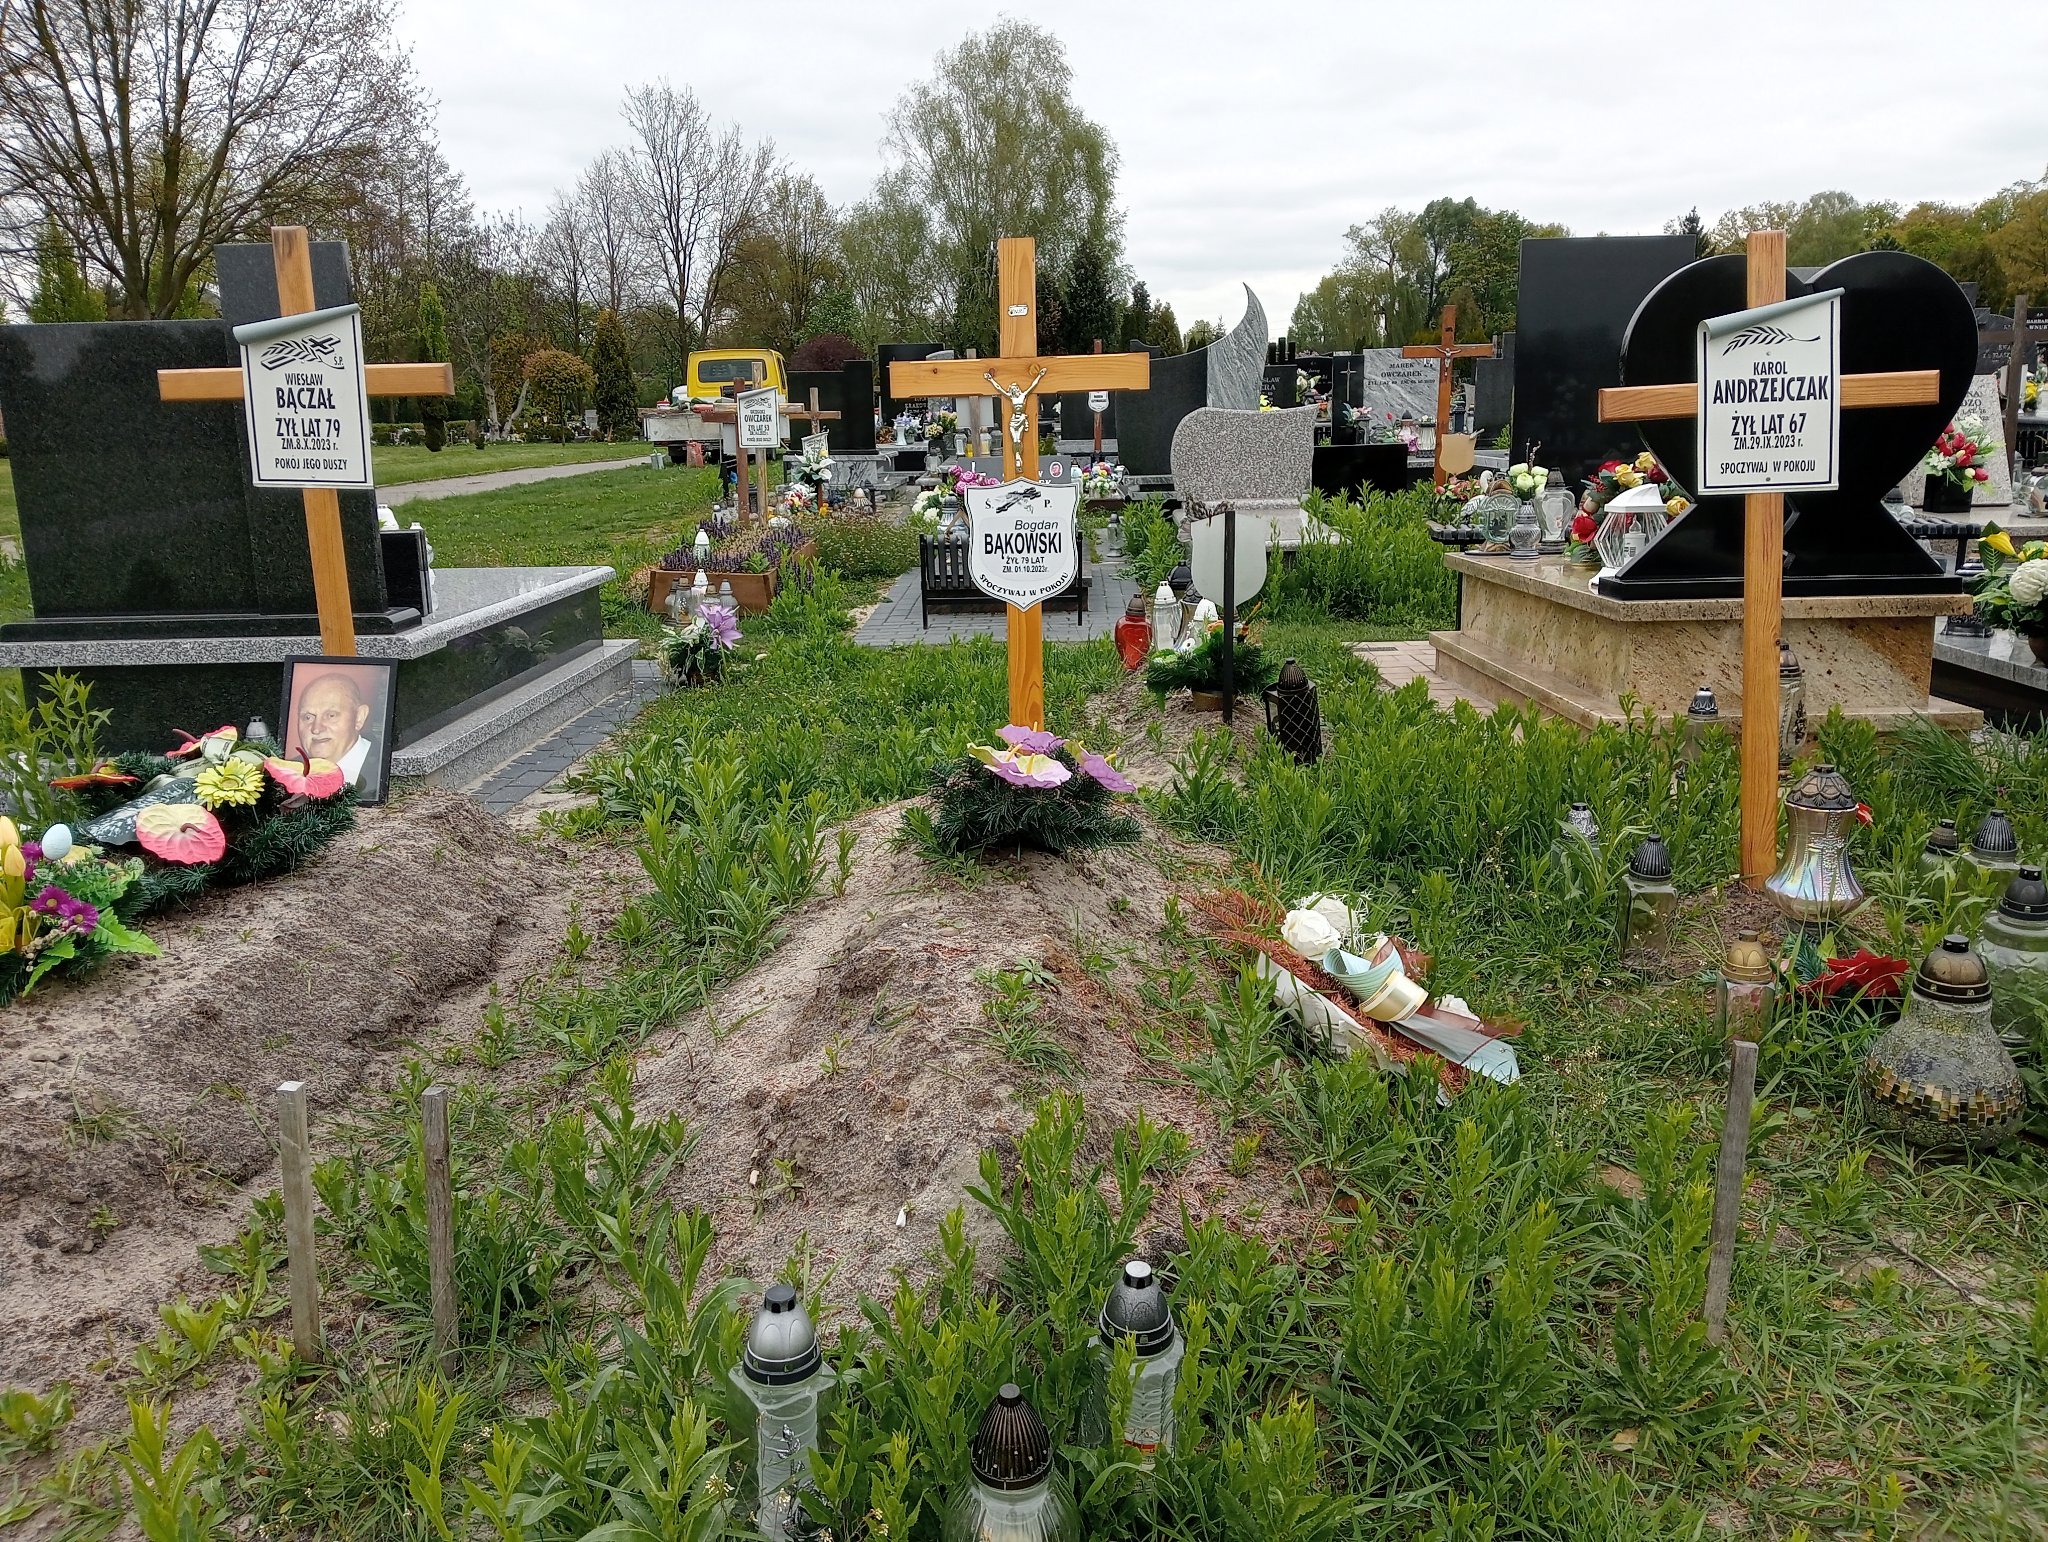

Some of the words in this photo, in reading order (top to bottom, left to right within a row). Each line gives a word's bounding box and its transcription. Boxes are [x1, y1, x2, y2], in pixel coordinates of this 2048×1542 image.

[1753, 361, 1788, 375] KAROL
[285, 373, 323, 386] WIESŁAW
[1713, 375, 1829, 404] ANDRZEJCZAK
[276, 388, 336, 414] BĄCZAŁ
[275, 412, 298, 437] ŻYŁ
[302, 418, 320, 437] LAT
[326, 419, 340, 438] 79
[1731, 410, 1756, 436] ŻYŁ
[1761, 414, 1784, 434] LAT
[1789, 412, 1807, 433] 67
[281, 438, 330, 450] ZM.8.X.2023
[332, 442, 338, 450] r.
[1734, 435, 1795, 450] ZM.29.IX.2023
[1797, 437, 1803, 447] r.
[275, 454, 300, 469] POKÓJ
[302, 458, 320, 470] JEGO
[323, 459, 348, 470] DUSZY
[1720, 462, 1768, 474] SPOCZYWAJ
[1773, 462, 1782, 472] W
[1784, 460, 1816, 472] POKOJU
[985, 498, 994, 509] Ś.
[1044, 500, 1052, 508] P.
[1015, 520, 1058, 532] Bogdan
[984, 532, 1061, 559] BĄKOWSKI
[1006, 556, 1018, 564] ŻYŁ
[1031, 556, 1045, 564] LAT
[979, 574, 1026, 597] SPOCZYWAJ
[1040, 572, 1068, 594] POKOJU
